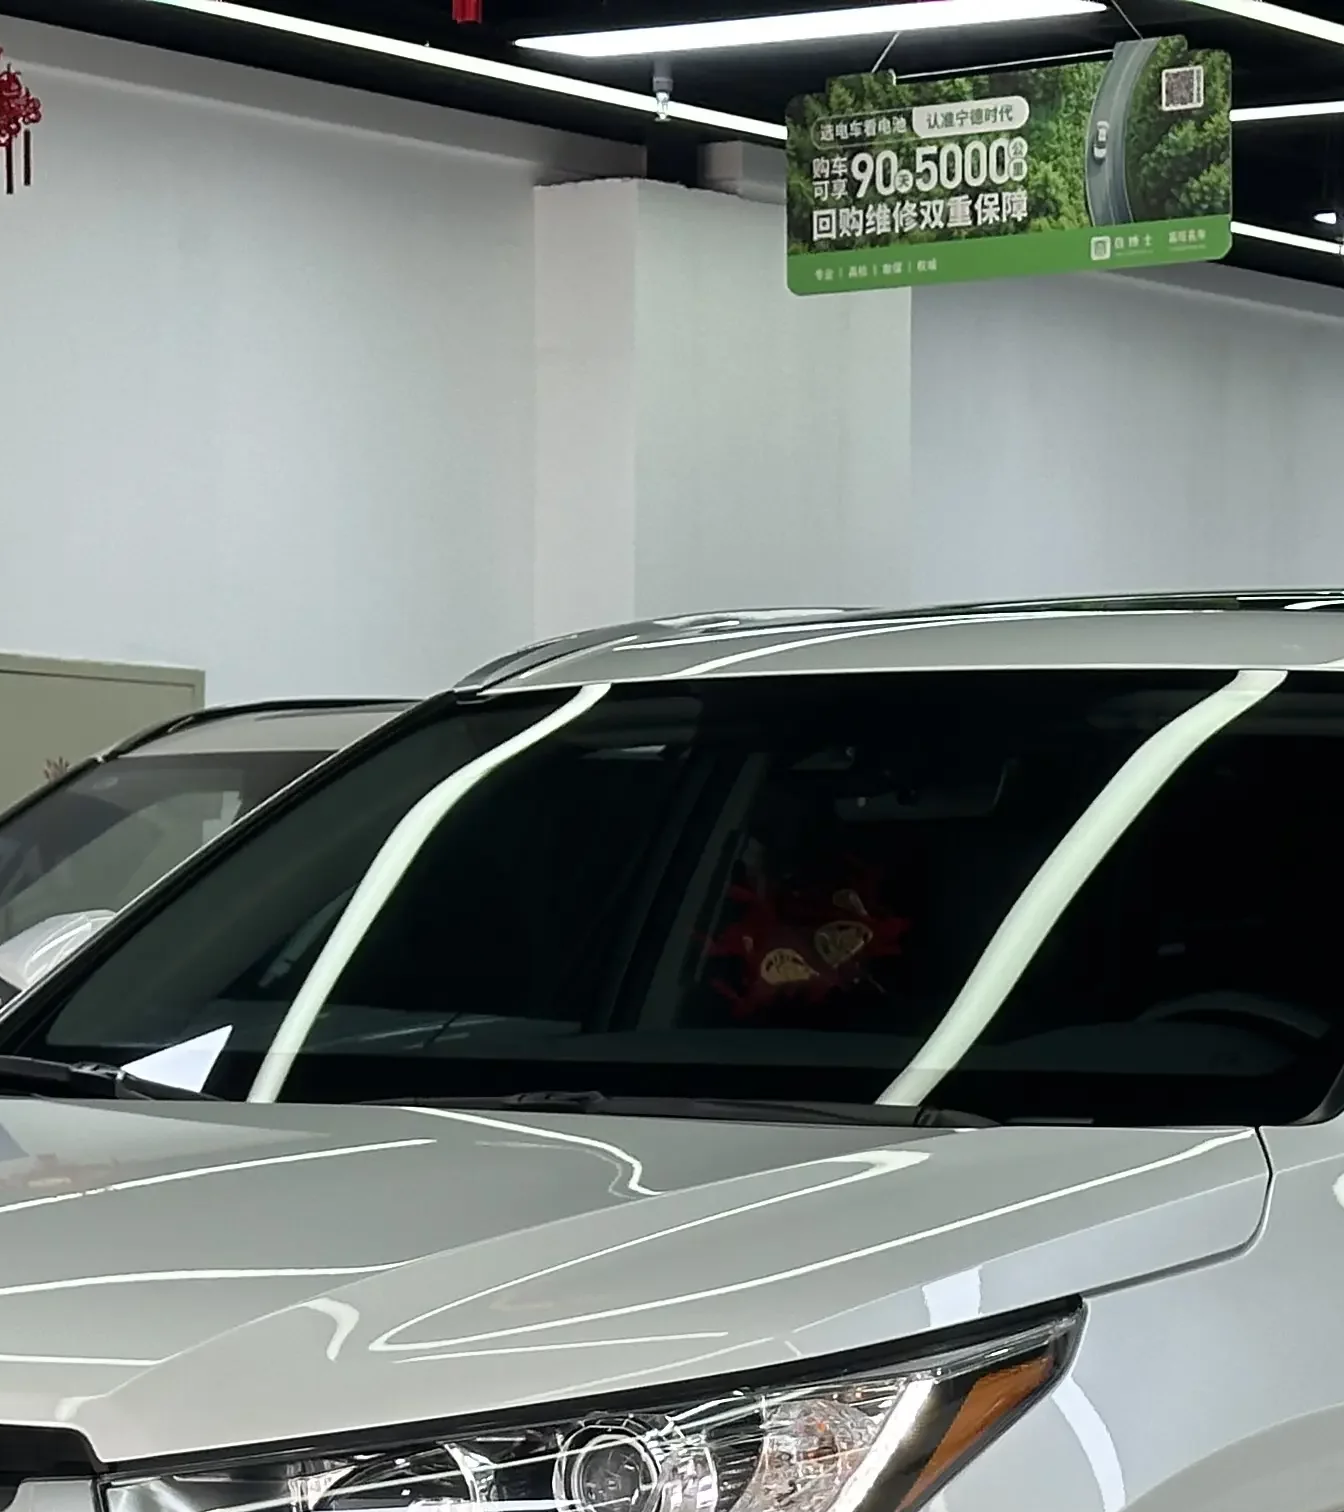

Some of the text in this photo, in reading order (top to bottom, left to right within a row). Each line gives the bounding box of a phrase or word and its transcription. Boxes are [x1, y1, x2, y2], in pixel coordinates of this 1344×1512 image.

[925, 103, 1014, 130] 认准宁德时代
[812, 157, 848, 179] 购车
[813, 179, 848, 202] 可享
[811, 187, 1029, 242] 回购维修双重保障
